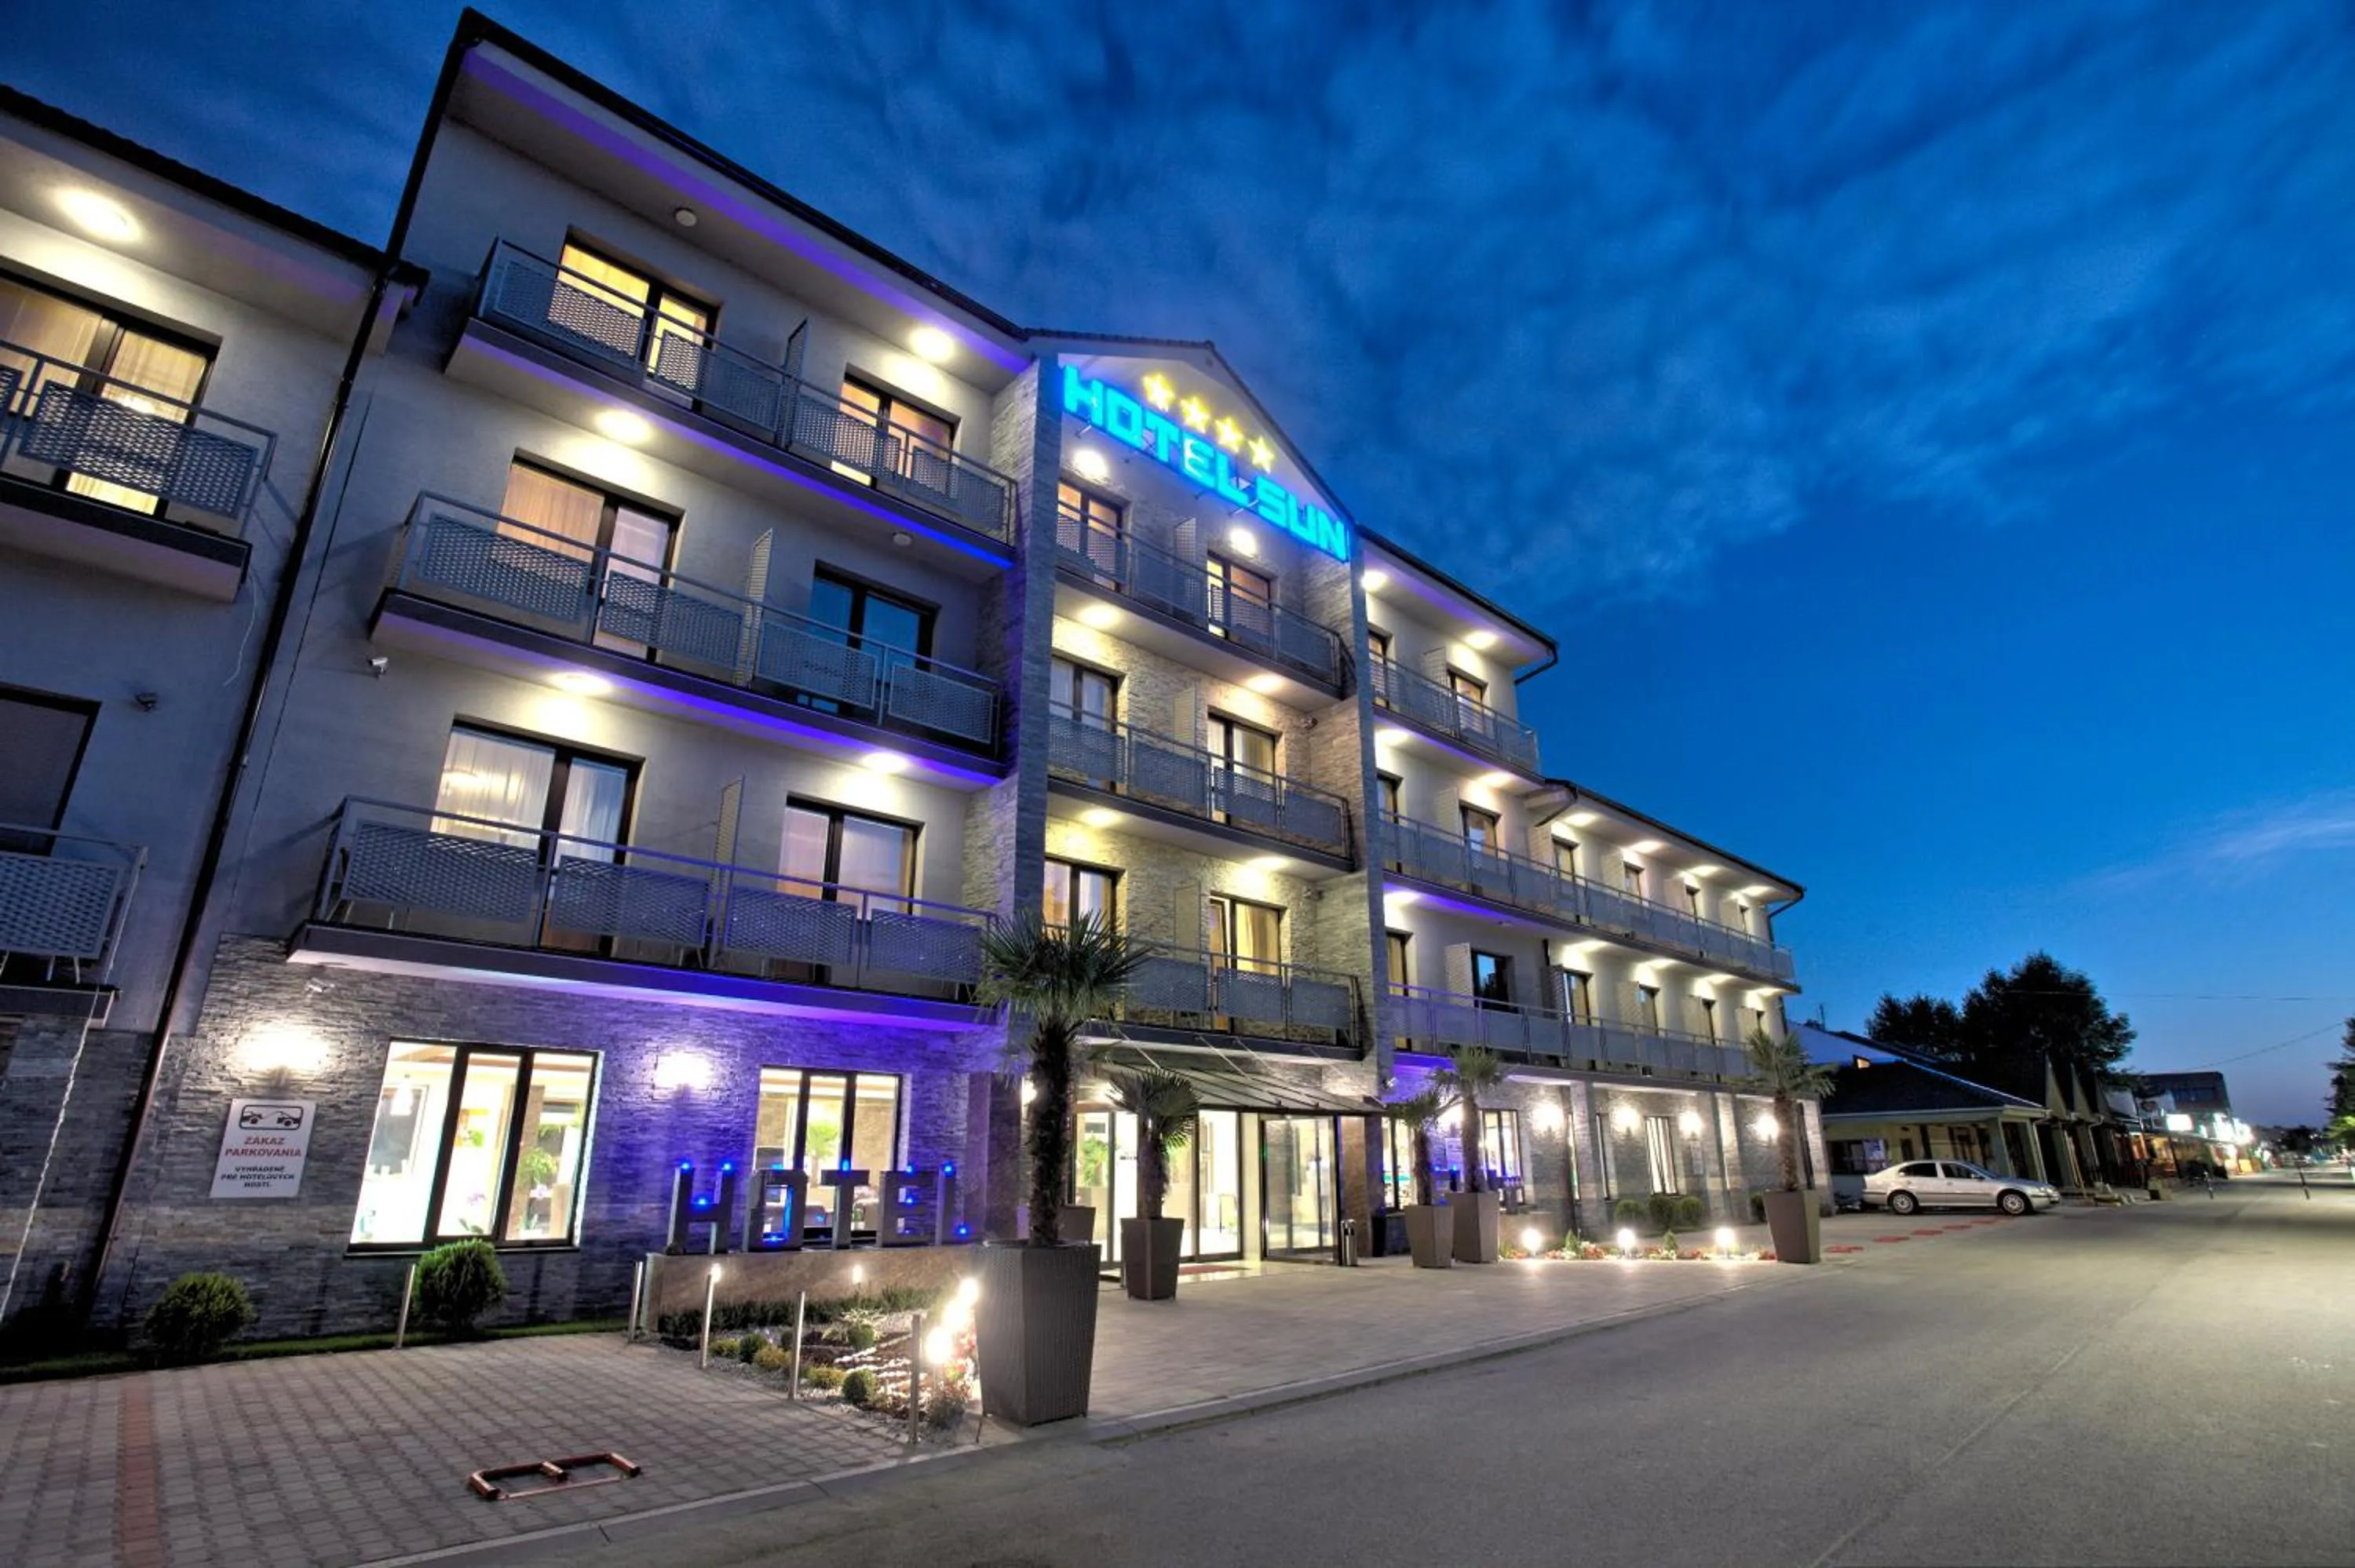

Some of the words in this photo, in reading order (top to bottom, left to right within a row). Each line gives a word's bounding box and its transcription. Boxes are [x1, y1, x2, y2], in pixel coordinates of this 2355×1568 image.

[1063, 363, 1250, 507] HOTEL
[1255, 473, 1349, 563] SUN
[225, 1148, 301, 1157] PARKOVANIA
[667, 1165, 977, 1256] HOTEL
